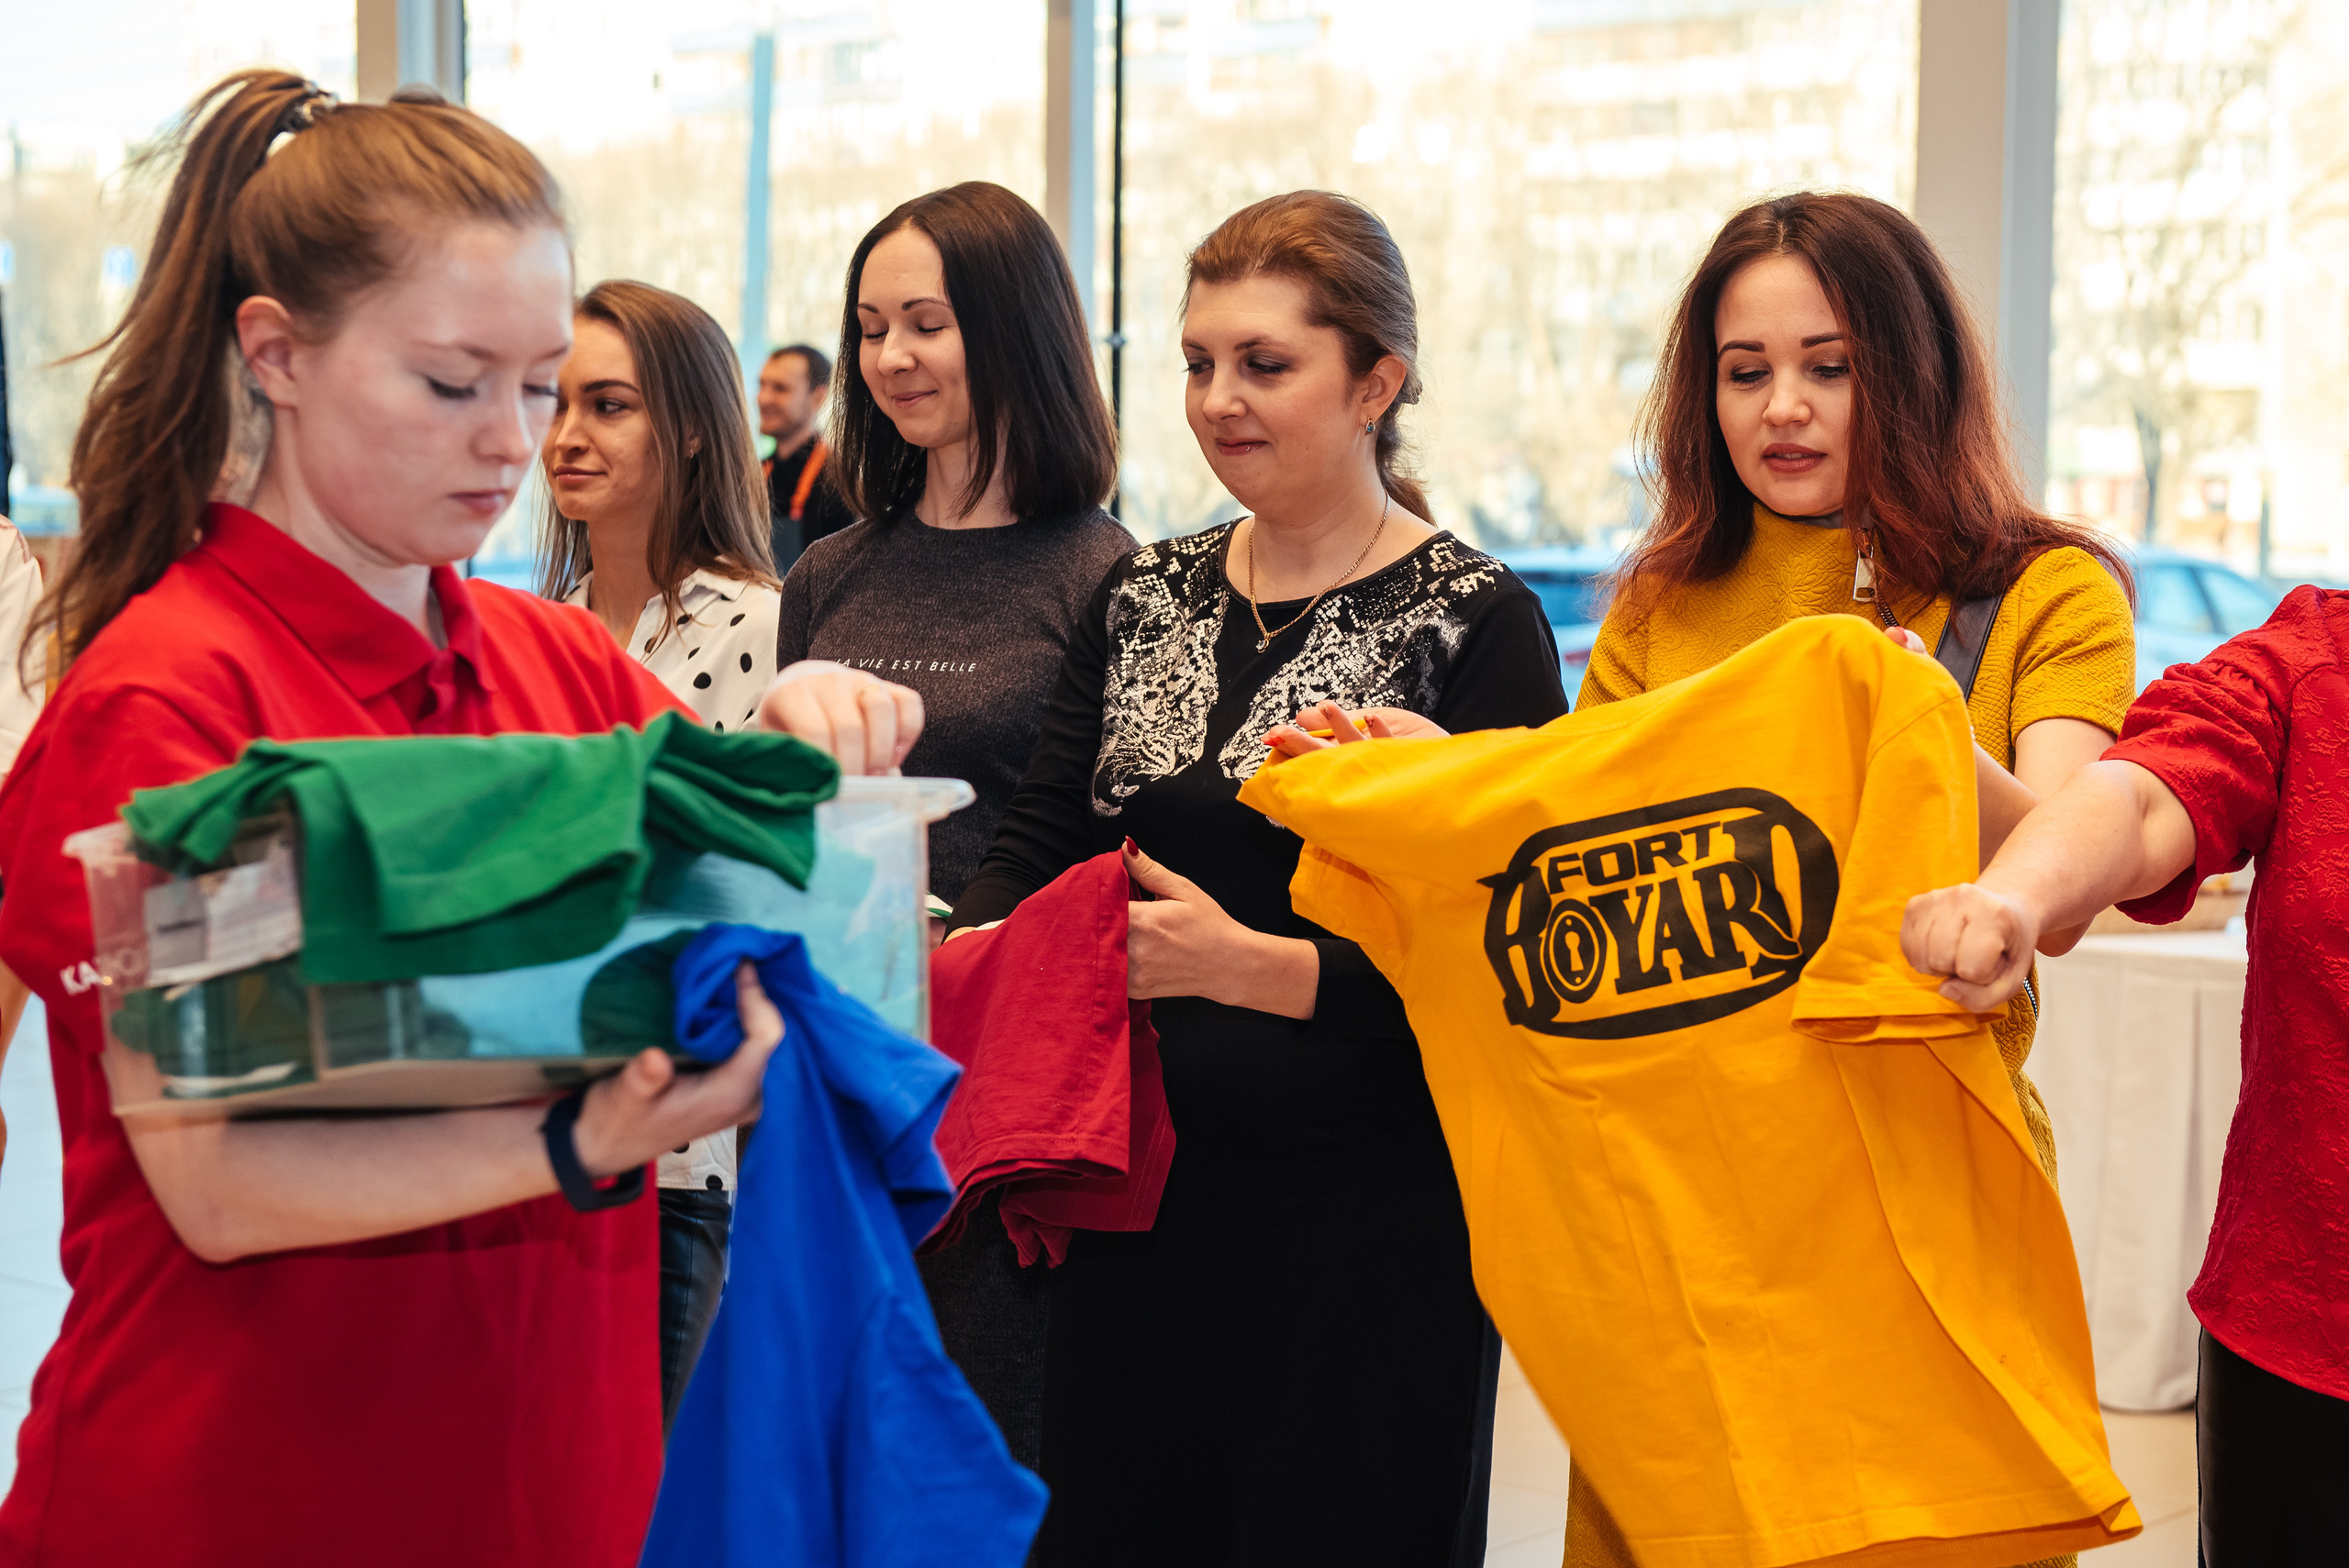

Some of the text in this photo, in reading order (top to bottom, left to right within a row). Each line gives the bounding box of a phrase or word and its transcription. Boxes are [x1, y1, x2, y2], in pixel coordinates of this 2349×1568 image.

[859, 658, 884, 669] VIE
[891, 660, 922, 671] EST
[929, 661, 977, 673] BELLE
[1547, 821, 1721, 895] FORT
[1478, 806, 1840, 1029] BOYARD
